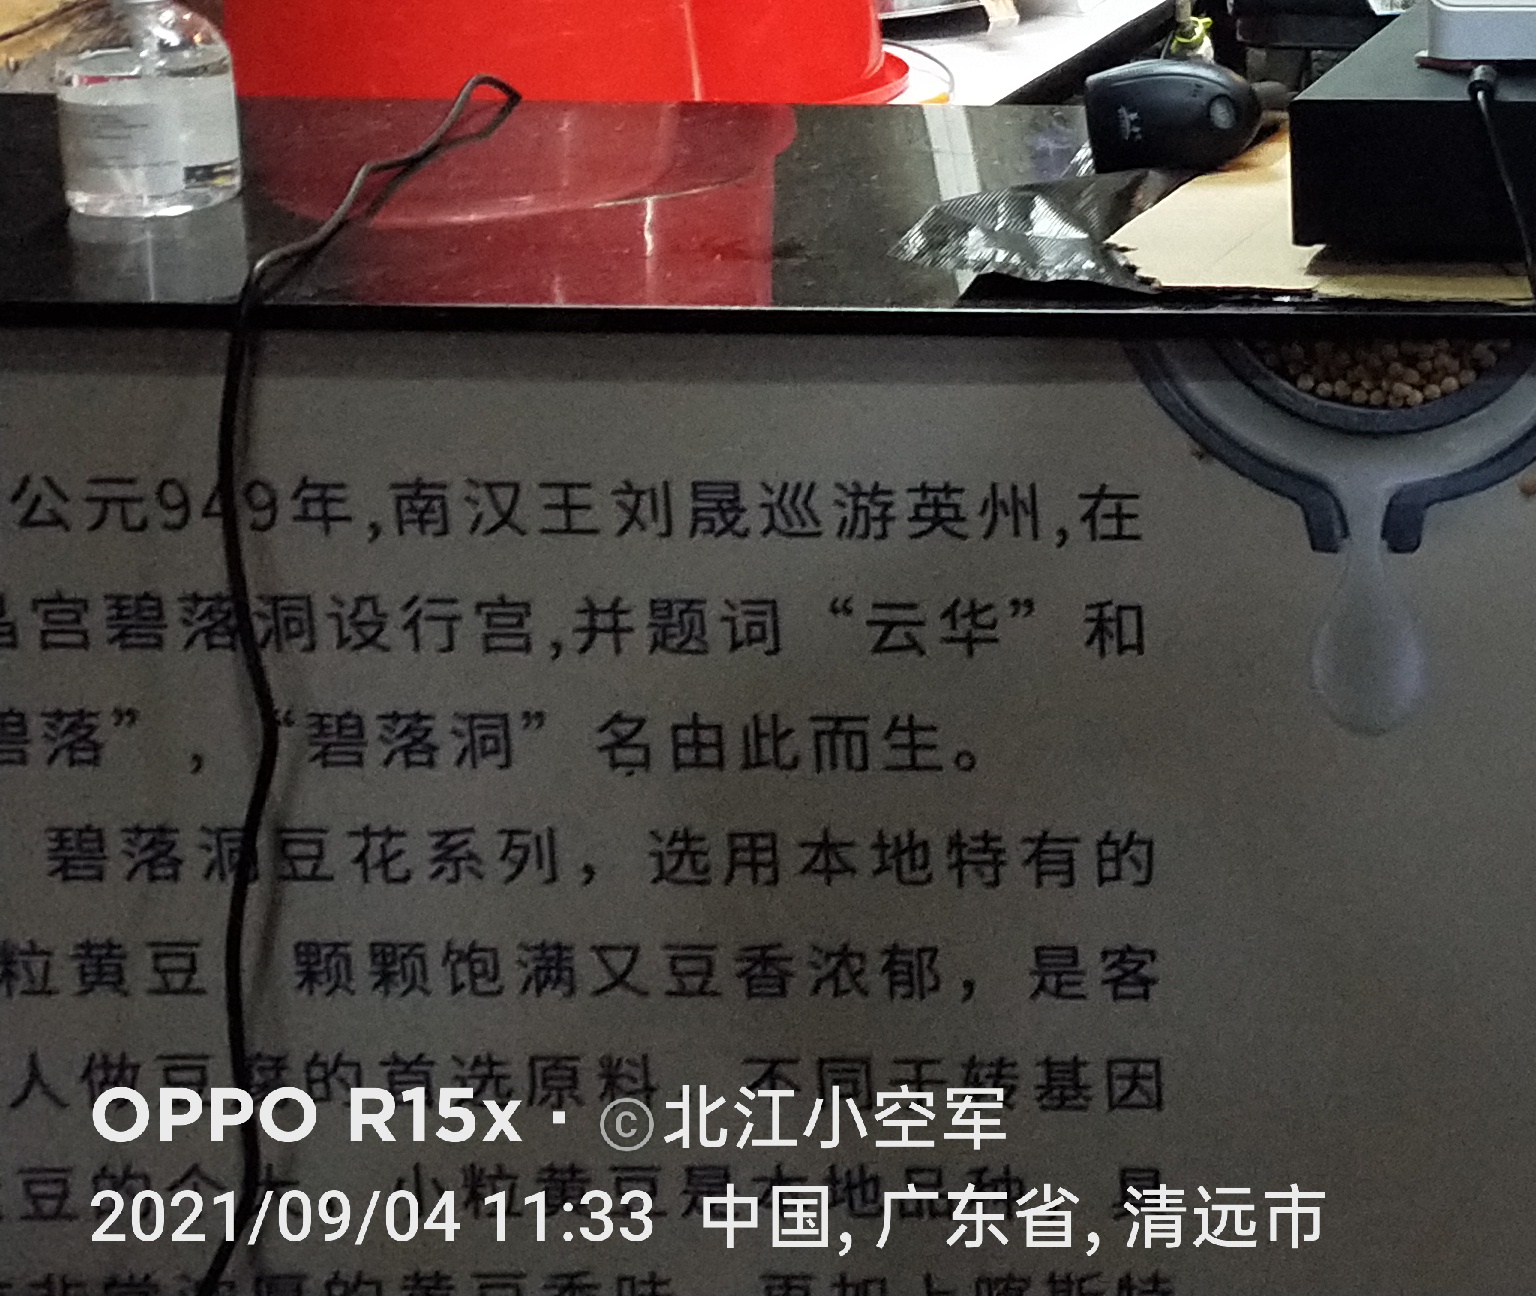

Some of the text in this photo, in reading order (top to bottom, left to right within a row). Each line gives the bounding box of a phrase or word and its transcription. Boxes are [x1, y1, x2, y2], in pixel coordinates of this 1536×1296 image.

[0, 939, 1160, 1003] 粒黄豆颗颗饱满又豆香浓郁，是客
